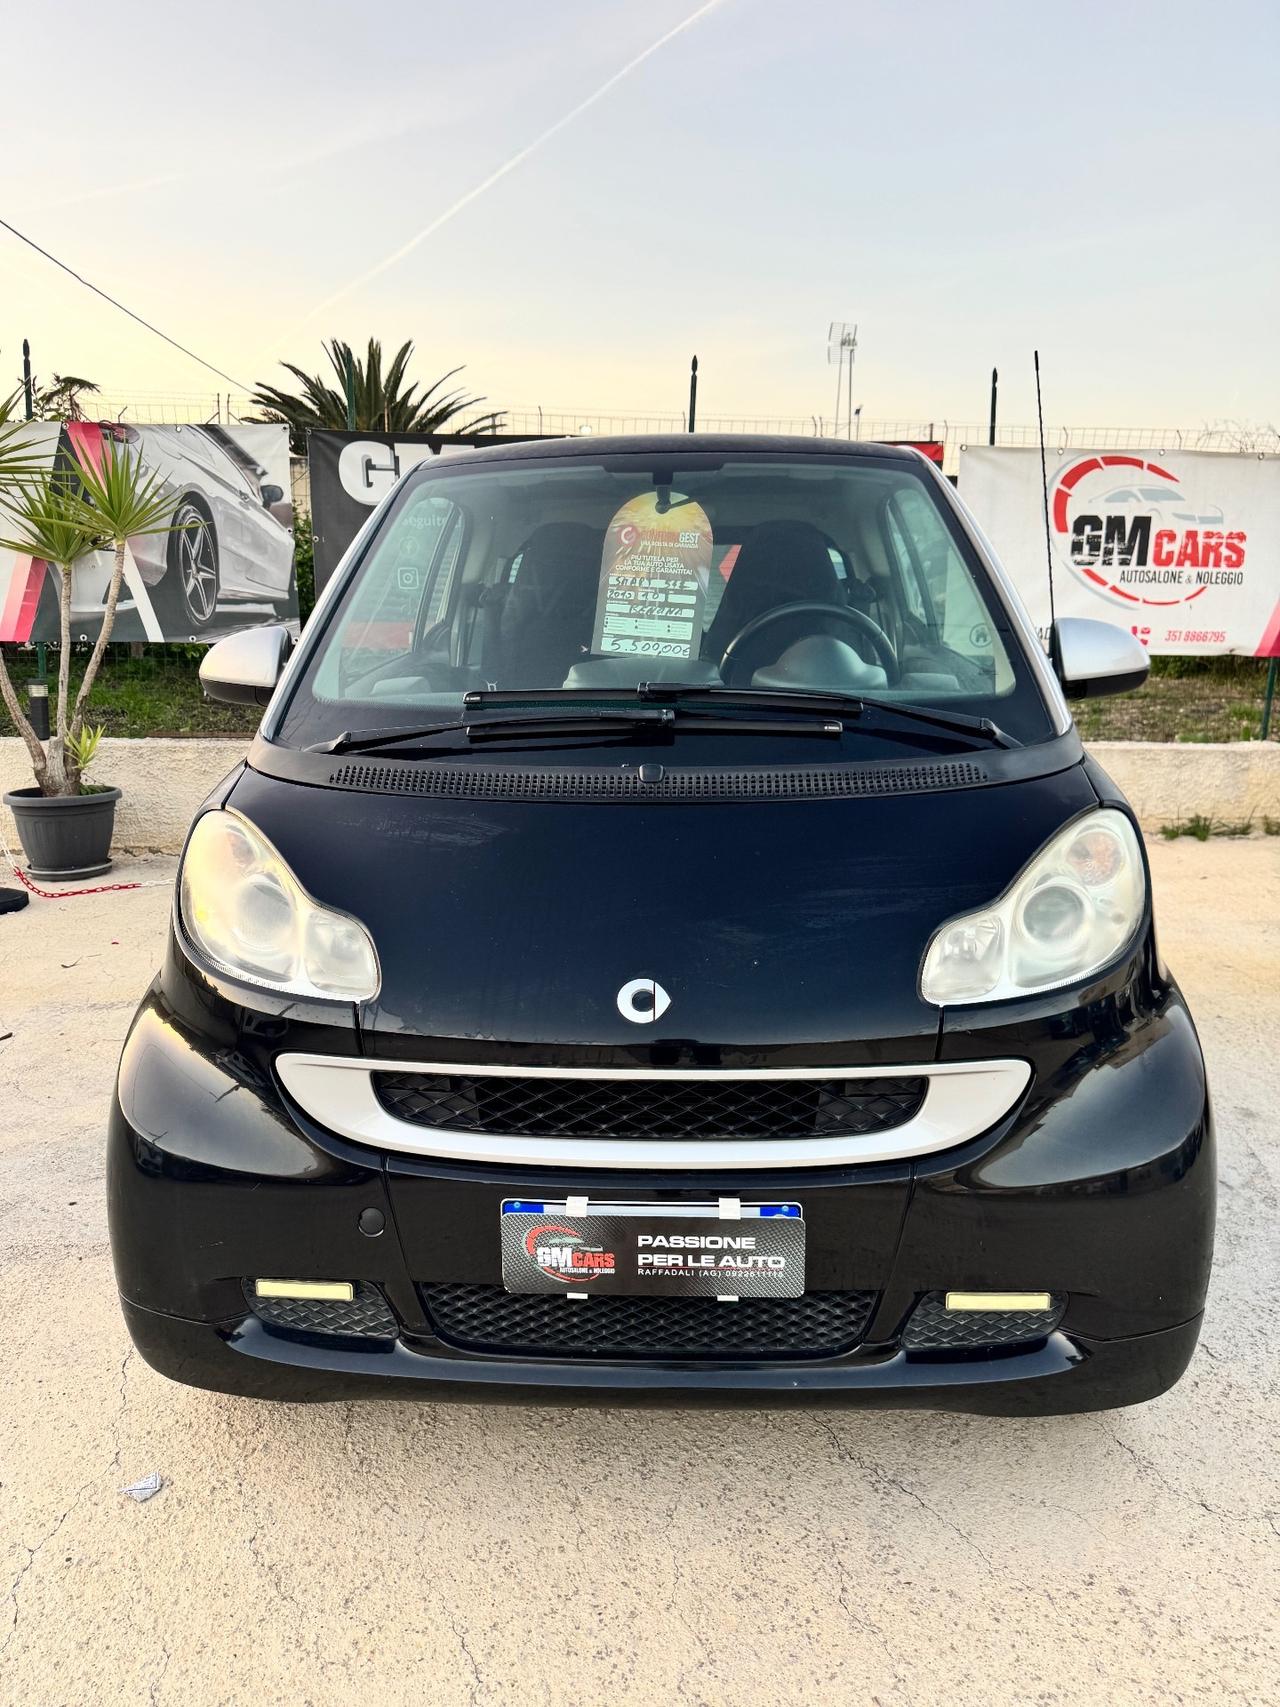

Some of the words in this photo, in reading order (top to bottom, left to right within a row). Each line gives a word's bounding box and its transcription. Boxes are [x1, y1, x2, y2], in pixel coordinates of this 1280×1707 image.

[1120, 570, 1182, 584] AUTOSALONE
[1195, 571, 1243, 585] NOLEGGIO
[1165, 629, 1182, 642] 351
[637, 1235, 756, 1249] PASSIONE
[572, 1252, 615, 1267] CARS
[637, 1254, 684, 1267] PER
[687, 1255, 715, 1267] LE
[718, 1256, 786, 1268] AUTO
[698, 1270, 722, 1278] (AG)
